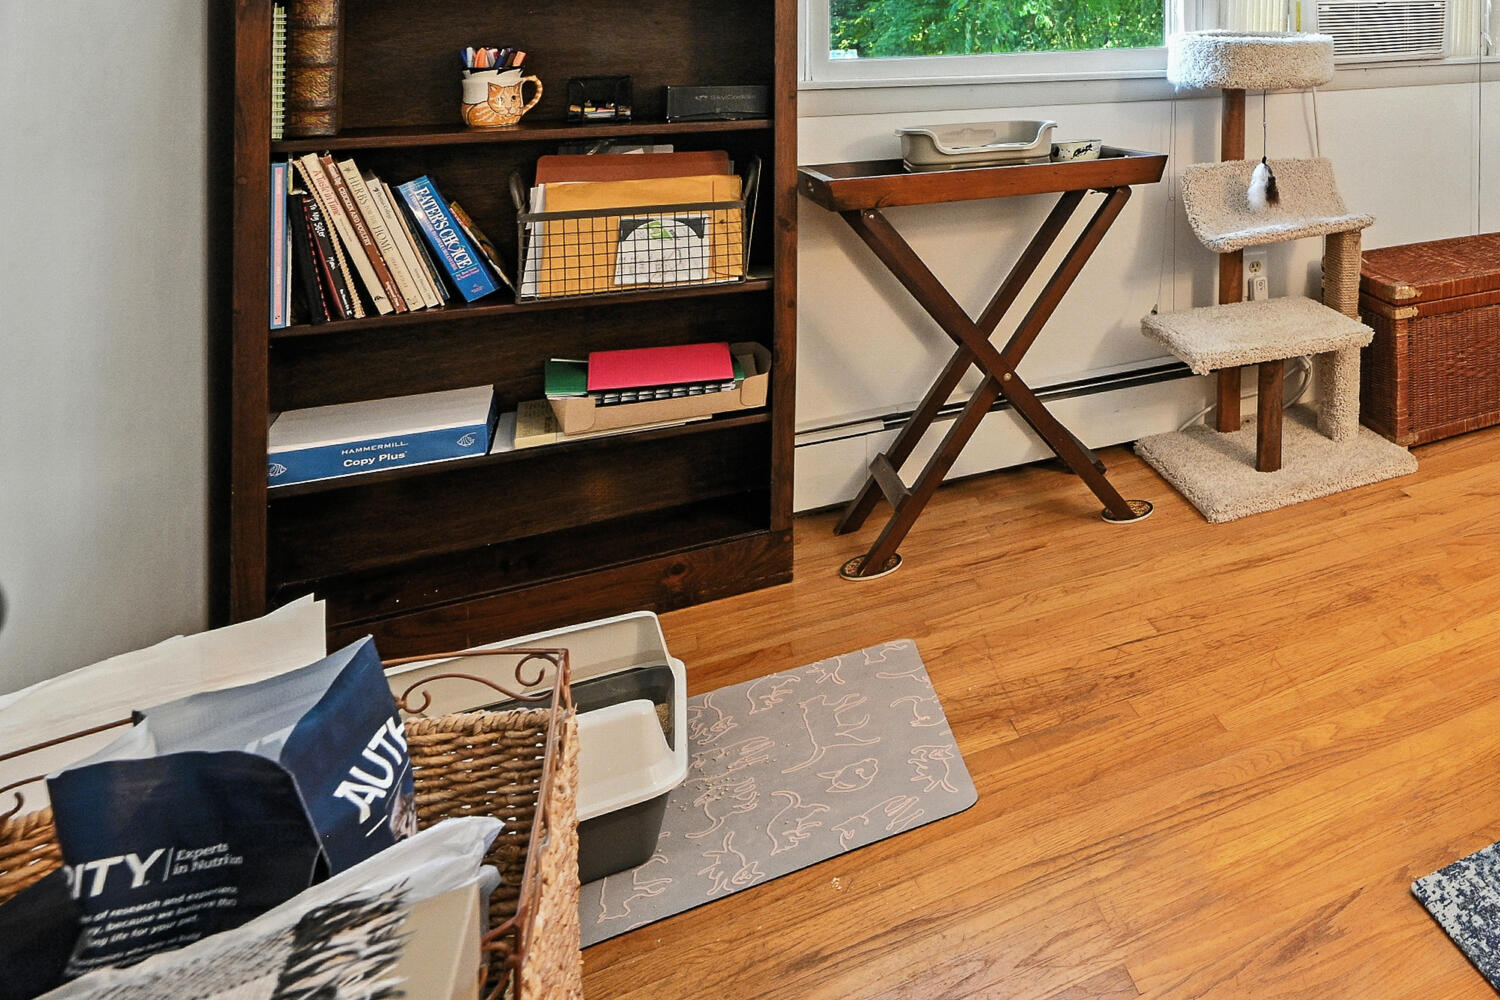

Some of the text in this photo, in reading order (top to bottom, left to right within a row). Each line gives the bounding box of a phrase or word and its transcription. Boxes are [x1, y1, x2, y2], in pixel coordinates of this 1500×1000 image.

[315, 175, 330, 193] Taste
[327, 198, 342, 217] Time
[337, 186, 355, 212] CHICKEN
[349, 175, 370, 208] HERBS
[372, 225, 393, 253] HOME
[349, 210, 360, 224] AND
[312, 220, 328, 239] Sister
[354, 221, 372, 247] POULTRY
[415, 186, 449, 231] EATER'S
[439, 228, 472, 269] CHOICE
[341, 441, 407, 455] HAMMERMILL
[343, 452, 406, 468] Copy Plus
[175, 842, 229, 862] Experts
[62, 848, 166, 900] ITY
[172, 864, 189, 876] in
[105, 914, 156, 933] because
[157, 909, 175, 921] we
[176, 901, 217, 917] believe
[110, 900, 161, 918] research
[162, 893, 186, 906] and
[111, 929, 132, 943] life
[149, 919, 178, 936] your
